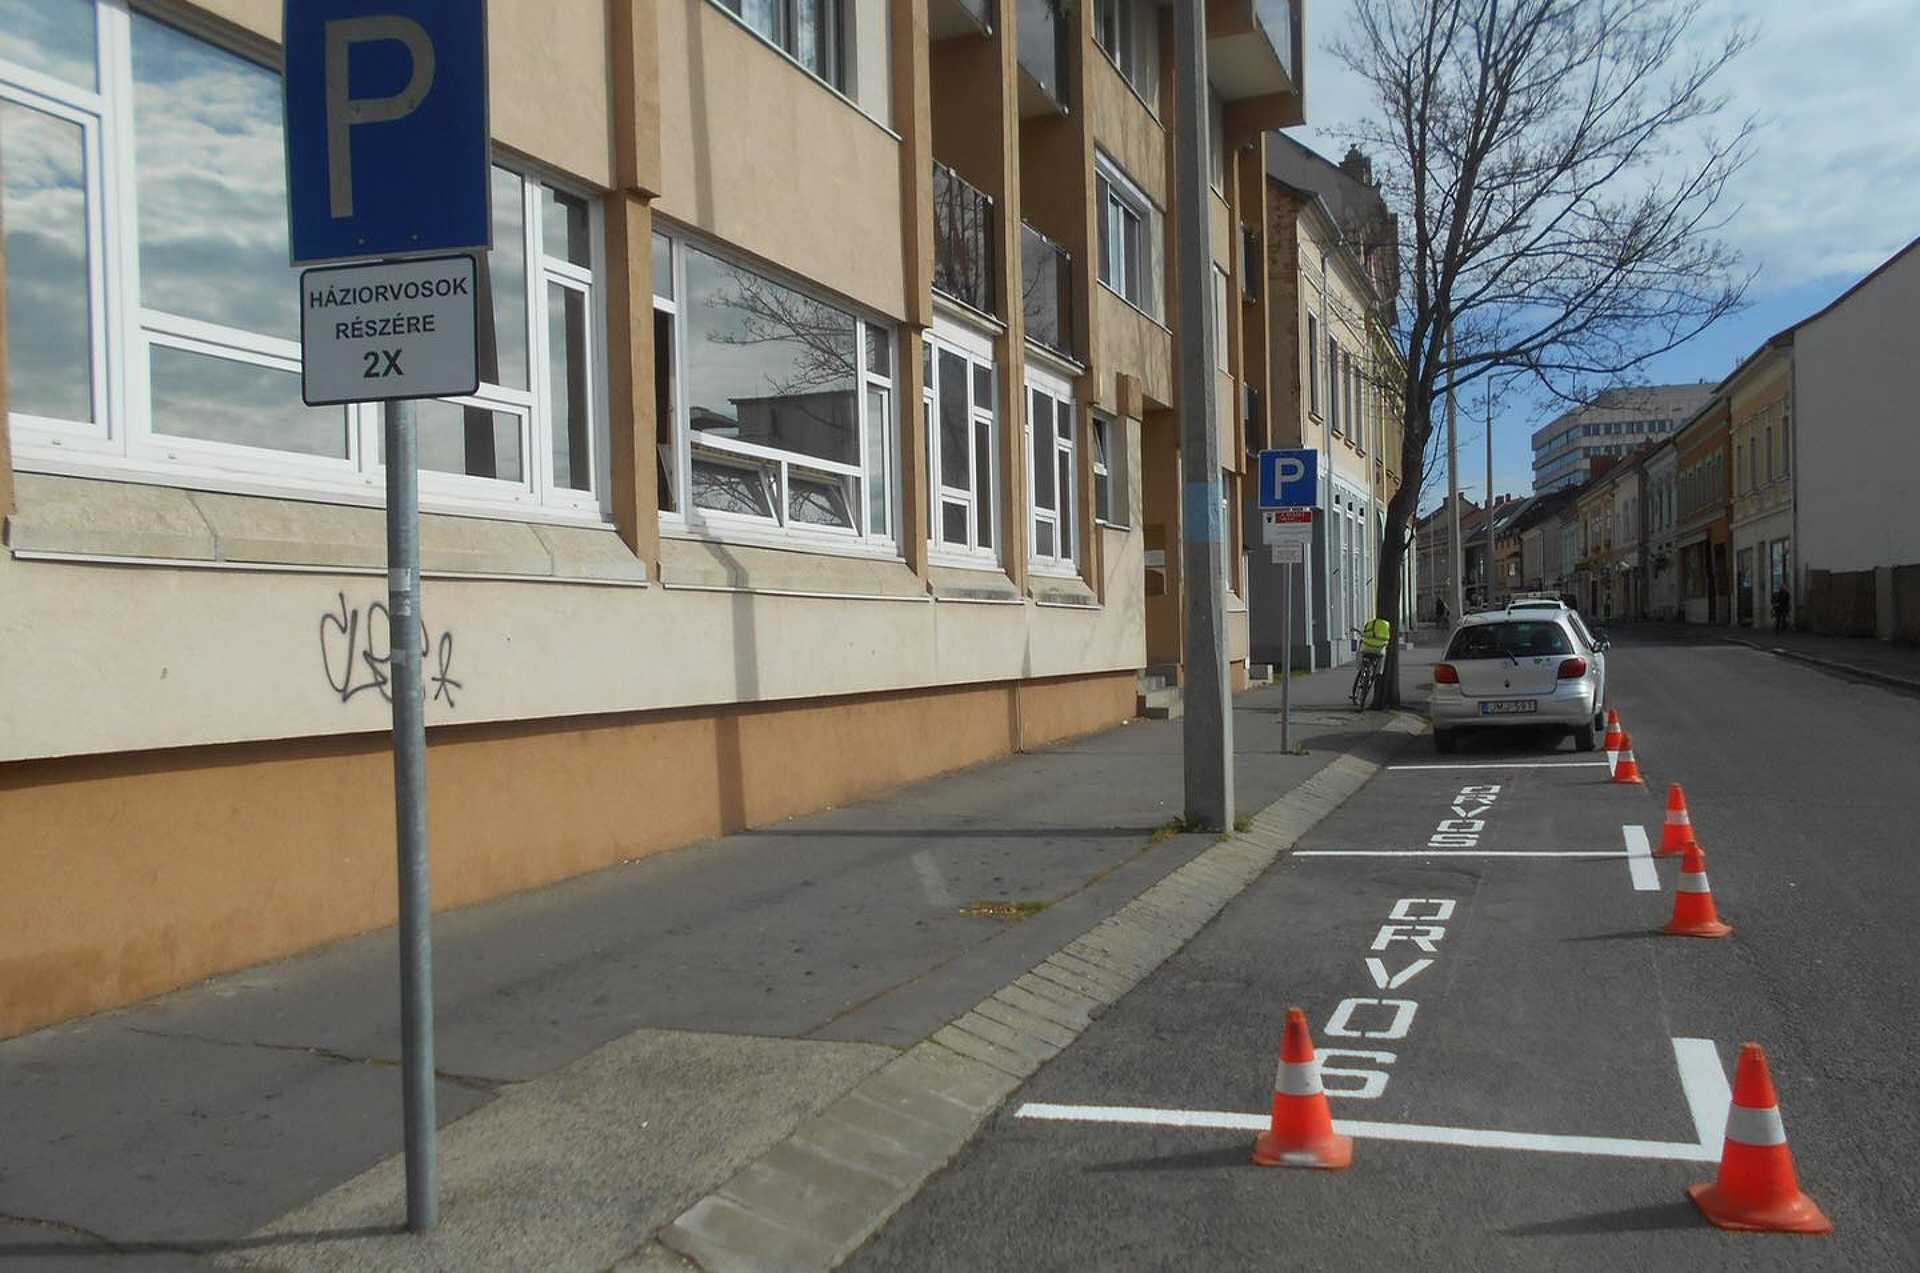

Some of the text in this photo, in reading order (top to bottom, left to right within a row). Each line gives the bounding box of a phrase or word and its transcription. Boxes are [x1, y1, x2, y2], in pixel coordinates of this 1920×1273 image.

[324, 14, 435, 219] P
[309, 276, 468, 308] HÁZIORVOSOK
[335, 313, 435, 340] RÉSZÉRE
[363, 349, 404, 379] 2X
[1274, 457, 1305, 499] P
[1427, 785, 1501, 847] ORVOS
[1314, 898, 1456, 1099] ORVOS
